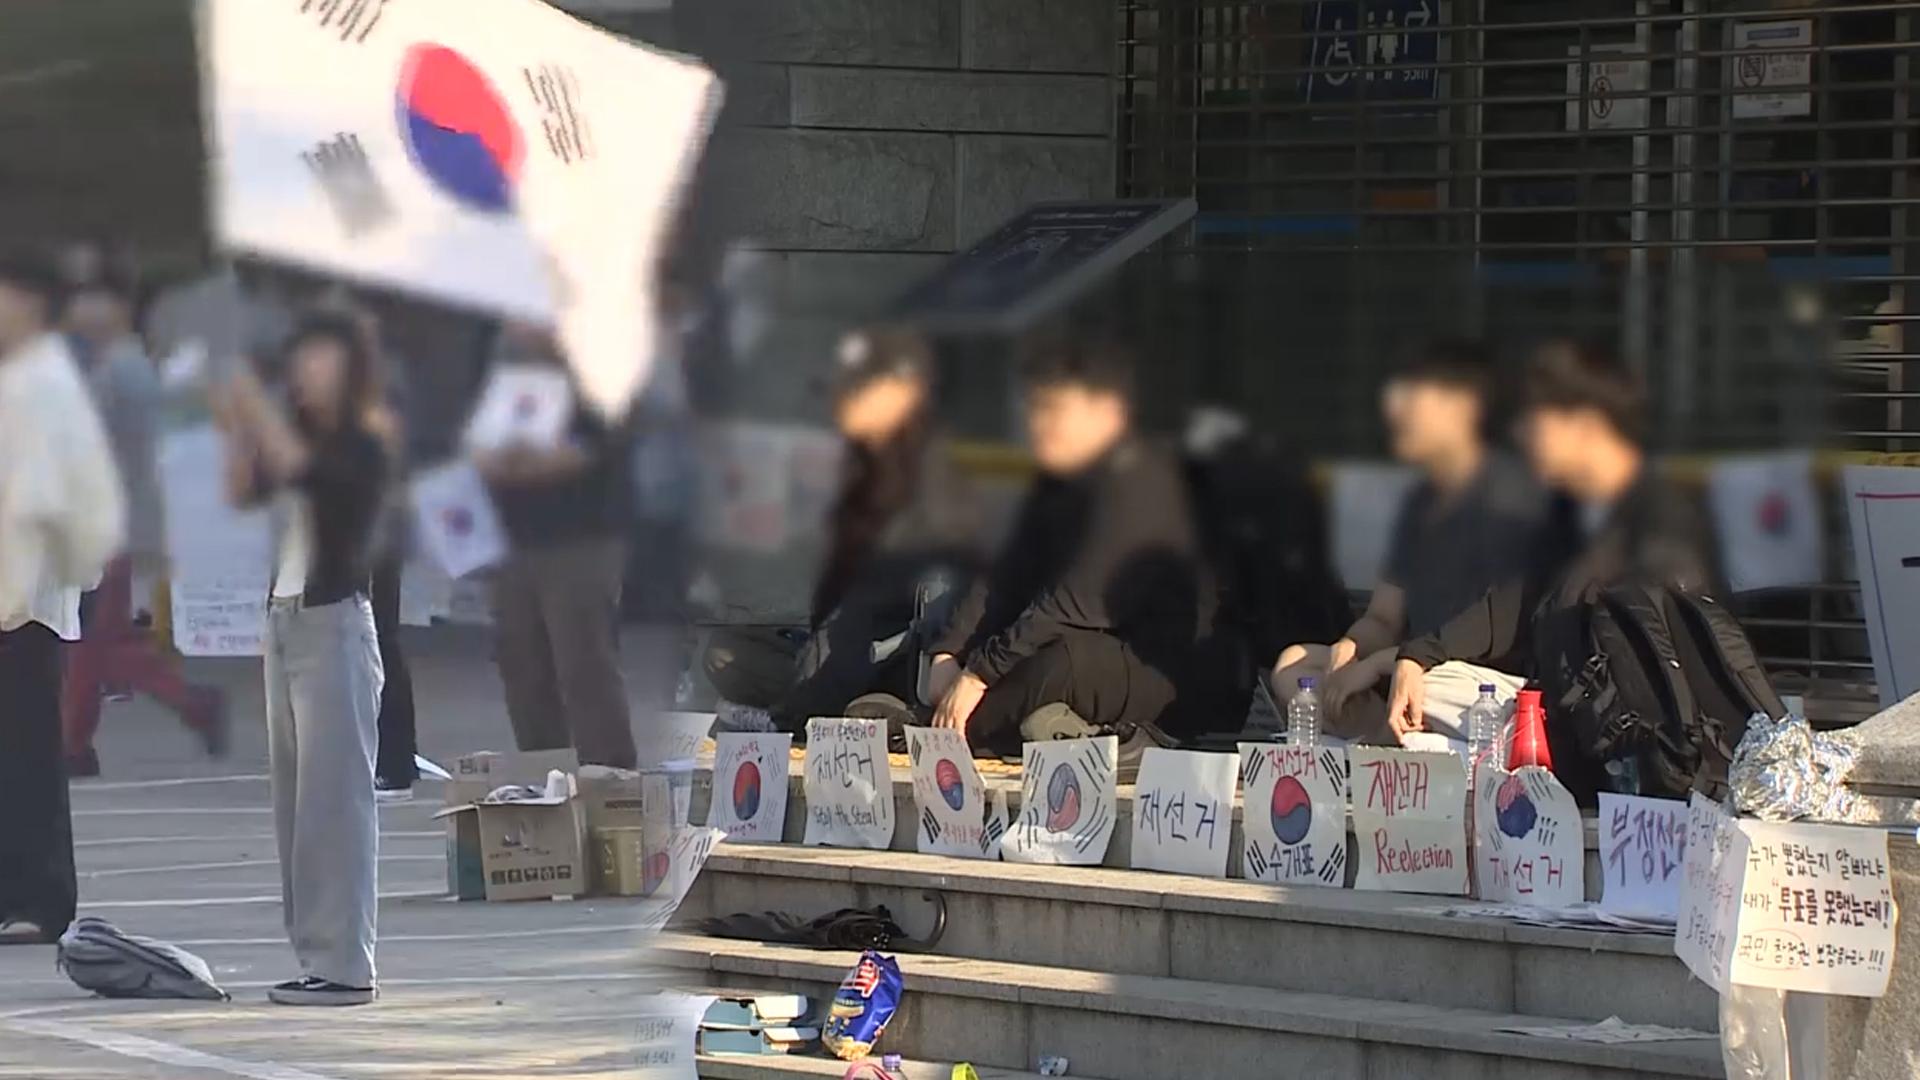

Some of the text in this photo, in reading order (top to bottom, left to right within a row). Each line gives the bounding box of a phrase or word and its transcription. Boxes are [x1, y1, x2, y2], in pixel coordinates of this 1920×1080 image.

[812, 743, 875, 792] 재선거
[1266, 746, 1317, 780] 재선거
[1361, 760, 1428, 817] 재선거
[1140, 787, 1218, 850] 재선거
[1269, 843, 1314, 880] 수개표
[1374, 828, 1453, 874] Reelection
[1749, 842, 1778, 871] 누가
[1782, 842, 1830, 878] 뽑혔는지
[1490, 855, 1563, 893] 재선거
[1743, 892, 1772, 912] 내가
[1739, 934, 1768, 961] 국민
[1774, 939, 1810, 966] 참정권
